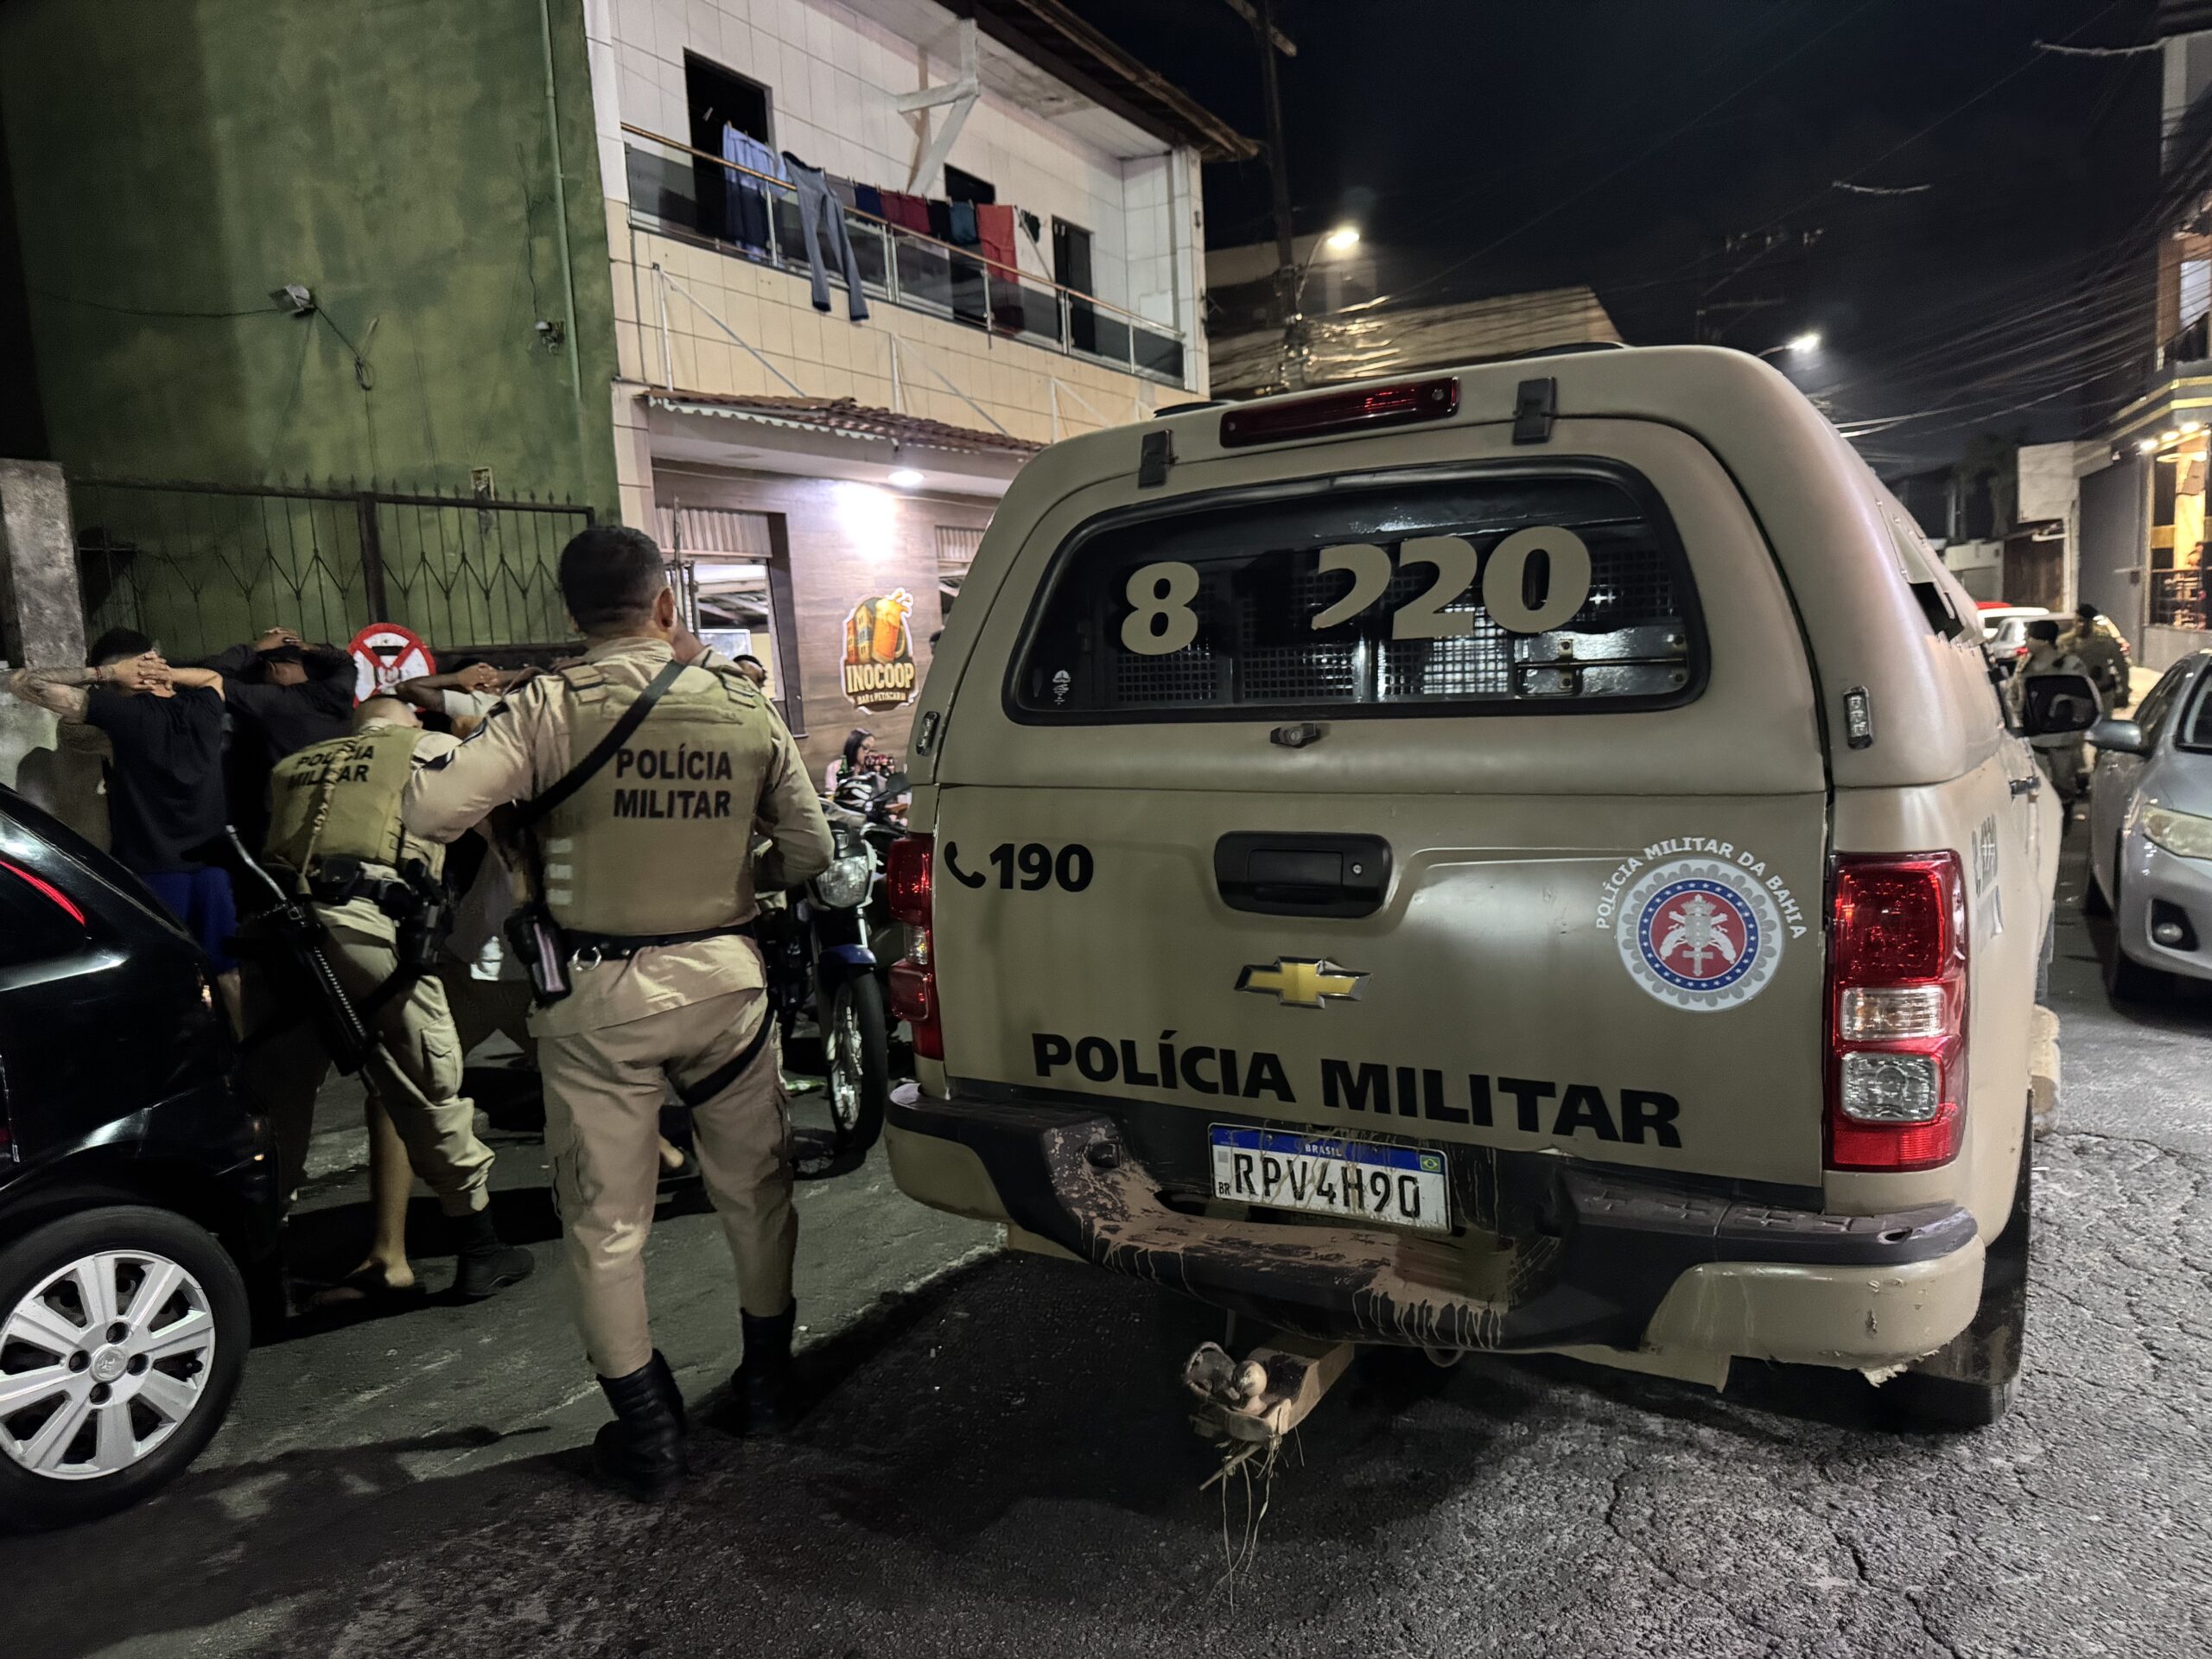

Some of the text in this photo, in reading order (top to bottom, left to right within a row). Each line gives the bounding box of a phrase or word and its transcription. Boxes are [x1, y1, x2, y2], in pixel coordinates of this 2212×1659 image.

[1121, 561, 1199, 656] 8
[846, 662, 915, 693] INOCOOP
[295, 745, 374, 769] POLIA
[616, 742, 733, 779] POLÍCIA
[288, 764, 370, 790] MILIAR
[613, 788, 731, 818] MILITAR
[989, 843, 1094, 893] 190
[1596, 836, 1808, 939] POLÍCIA MILITAR DA BAHIA
[1032, 1029, 1682, 1148] POLÍCIA MILITAR
[1305, 1143, 1342, 1157] BRASIL
[1218, 1181, 1230, 1196] BR
[1234, 1153, 1421, 1218] RPV4H90
